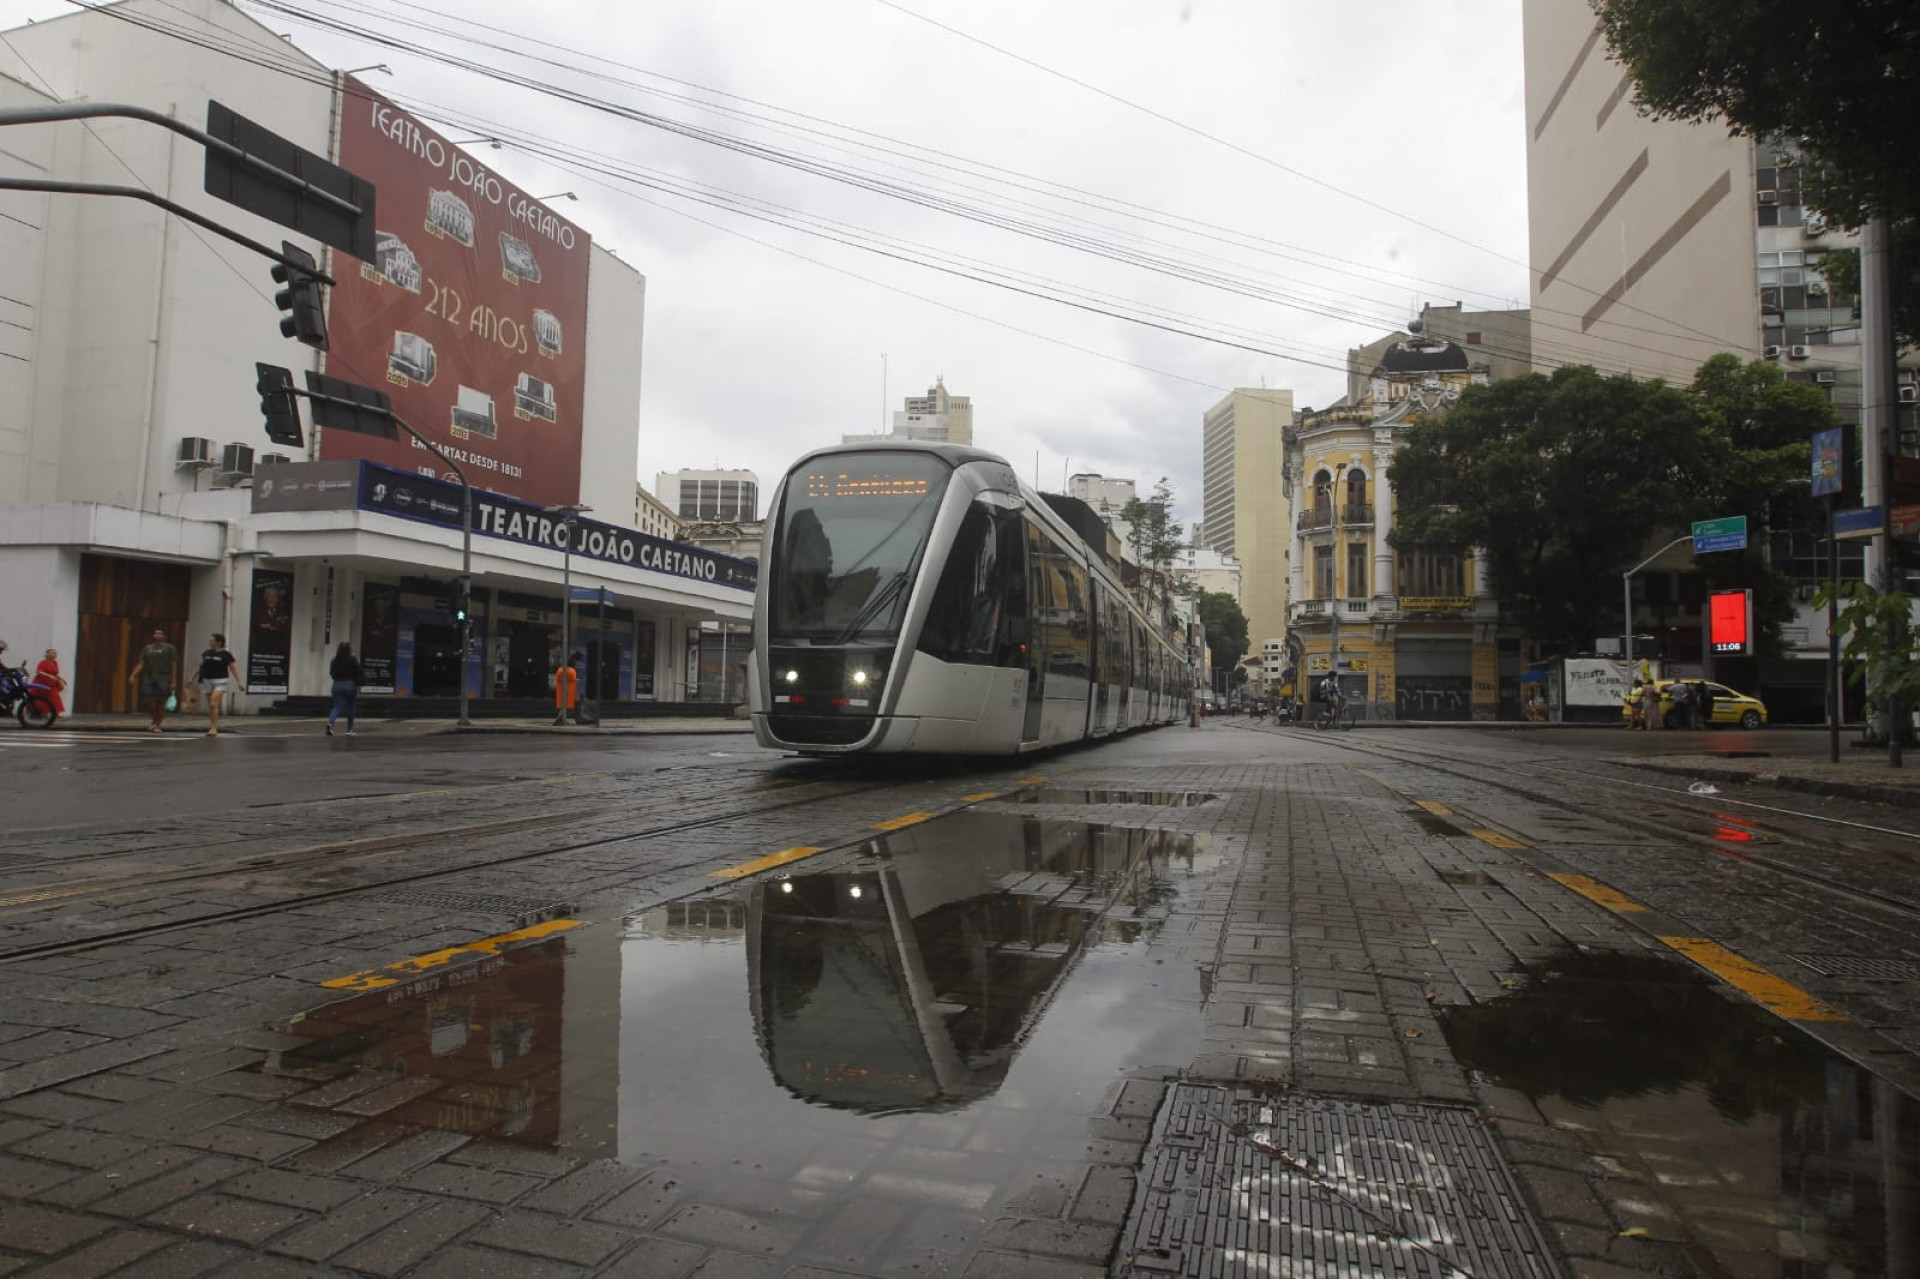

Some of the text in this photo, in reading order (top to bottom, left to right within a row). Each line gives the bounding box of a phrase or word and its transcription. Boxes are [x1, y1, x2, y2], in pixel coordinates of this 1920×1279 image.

[371, 100, 575, 250] TEATRO JOÃO CAETANO
[424, 278, 528, 355] 212 ANOS
[469, 452, 499, 472] DESDE
[479, 503, 717, 581] TEATRO JOÃO CAETANO
